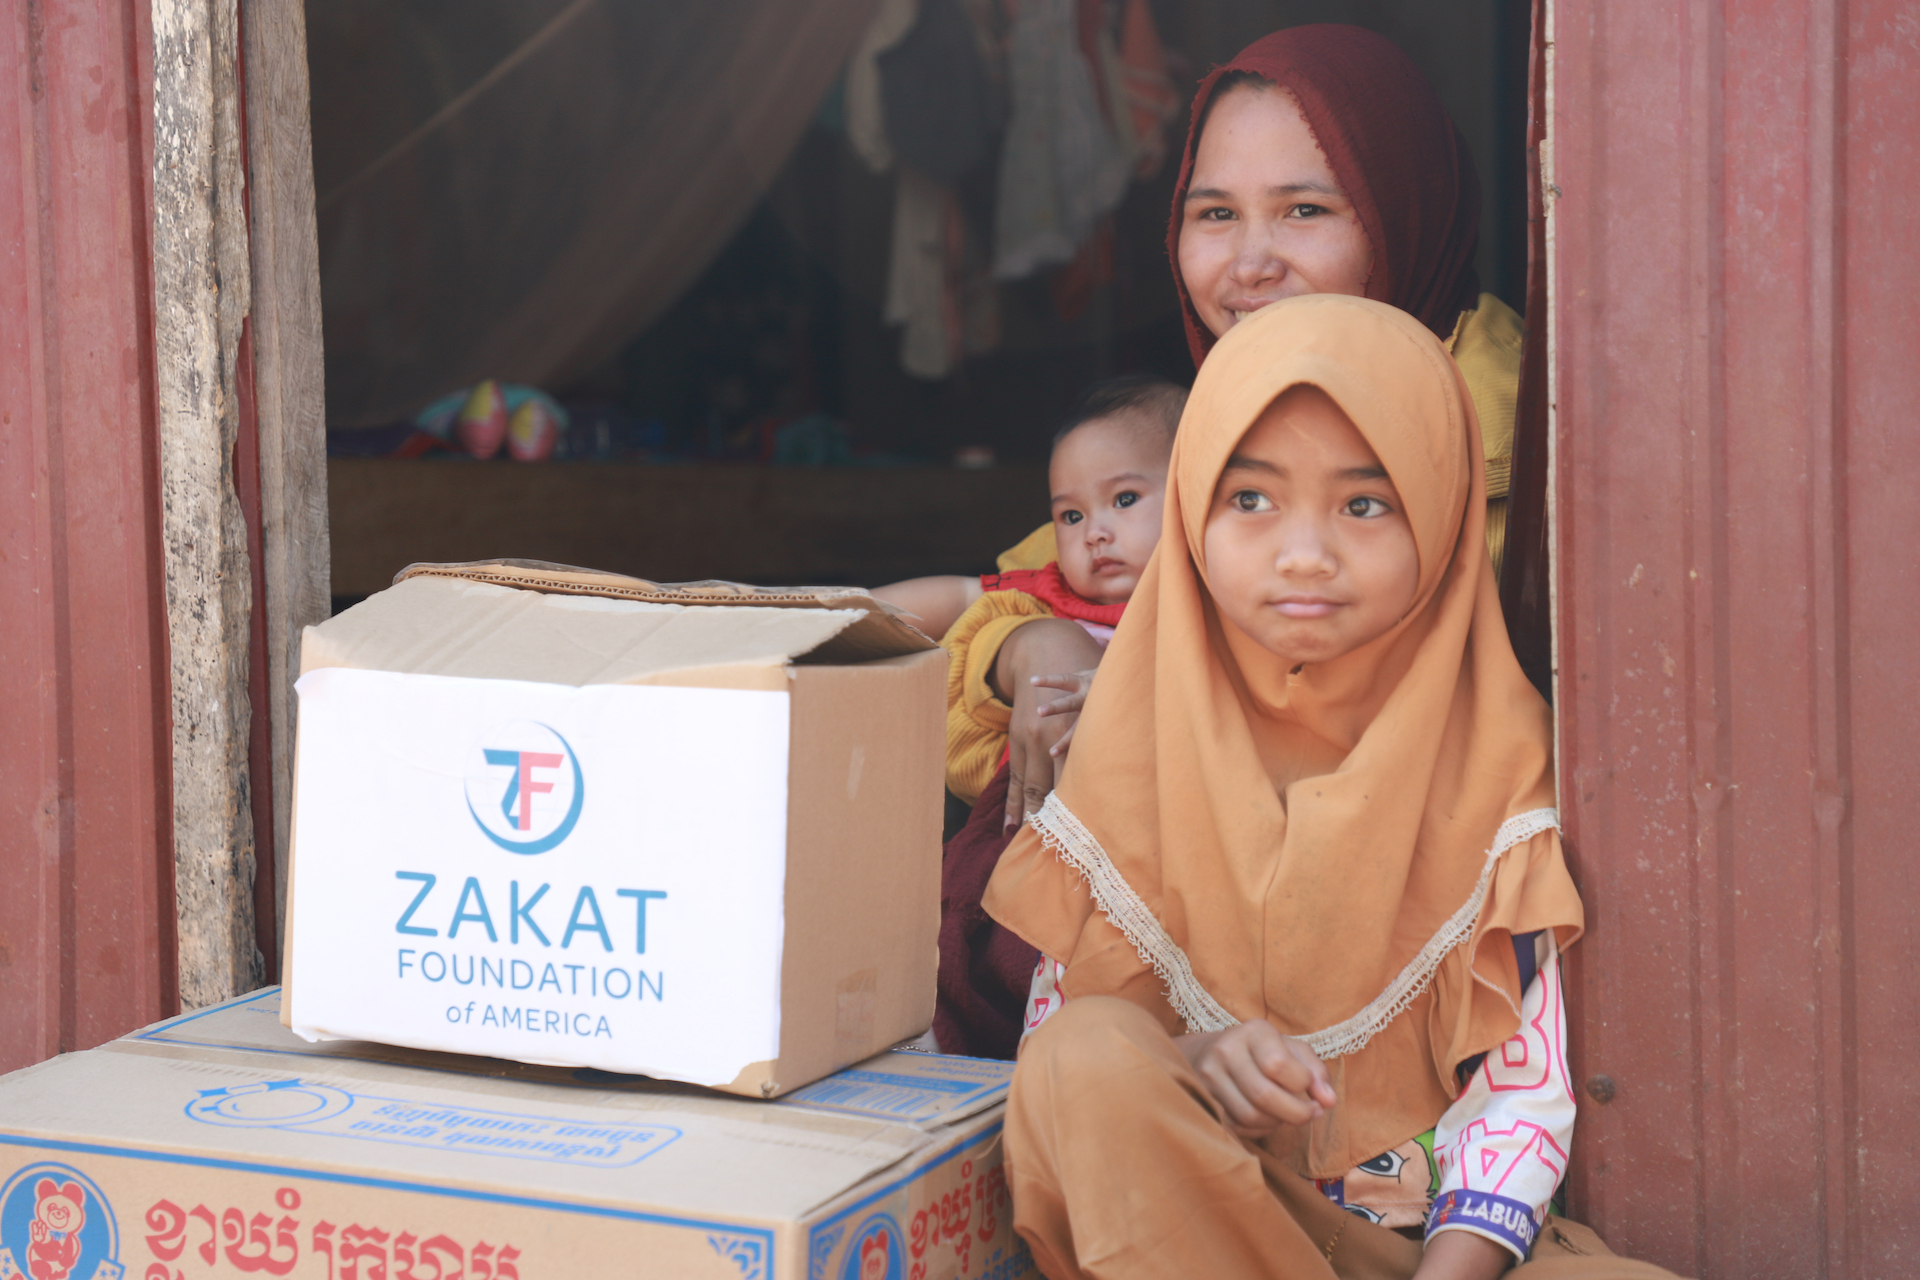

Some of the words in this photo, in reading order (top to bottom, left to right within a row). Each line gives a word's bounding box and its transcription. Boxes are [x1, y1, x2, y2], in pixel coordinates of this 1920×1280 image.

[395, 870, 667, 954] ZAKAT
[398, 948, 664, 1002] FOUNDATION
[446, 1001, 475, 1025] of
[482, 1004, 612, 1039] AMERICA
[1461, 1197, 1534, 1247] LABUBU
